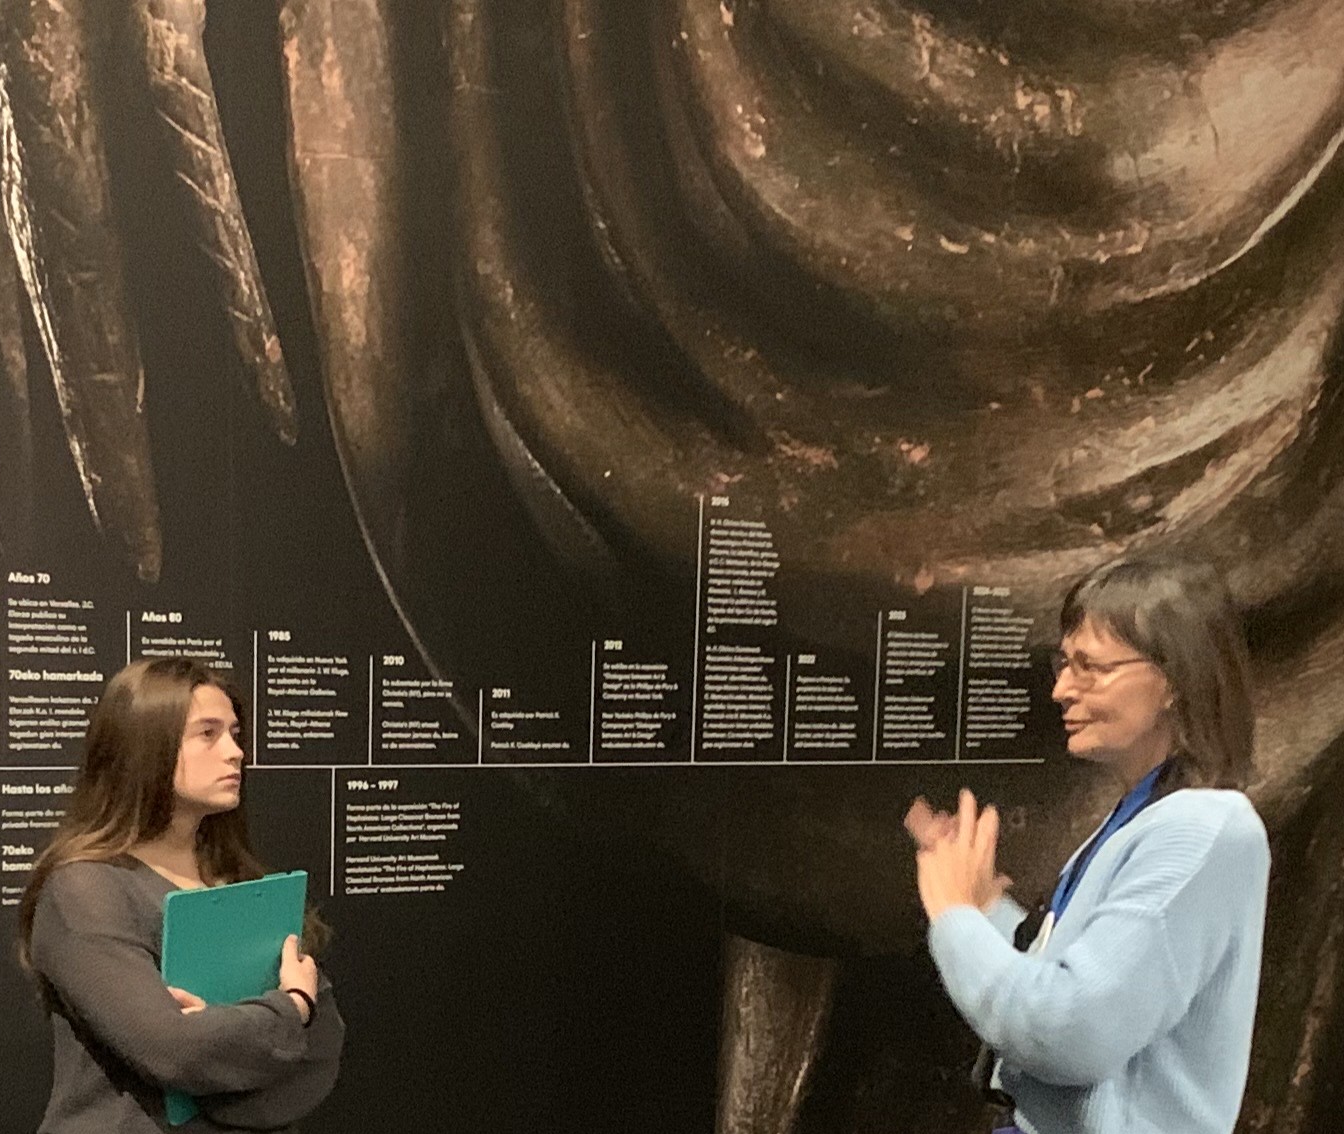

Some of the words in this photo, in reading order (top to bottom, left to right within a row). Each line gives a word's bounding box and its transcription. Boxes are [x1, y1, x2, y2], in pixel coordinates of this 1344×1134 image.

[8, 572, 34, 583] Años
[37, 573, 50, 584] 70
[142, 612, 167, 622] Años
[169, 612, 182, 622] 80
[383, 656, 404, 665] 2010
[9, 670, 41, 680] 70eko
[43, 670, 103, 681] hamarkada
[492, 688, 510, 698] 2011
[2, 784, 34, 794] Hasta
[36, 784, 51, 794] los
[348, 781, 368, 790] 1996
[378, 780, 398, 790] 1997
[2, 845, 34, 855] 70eko
